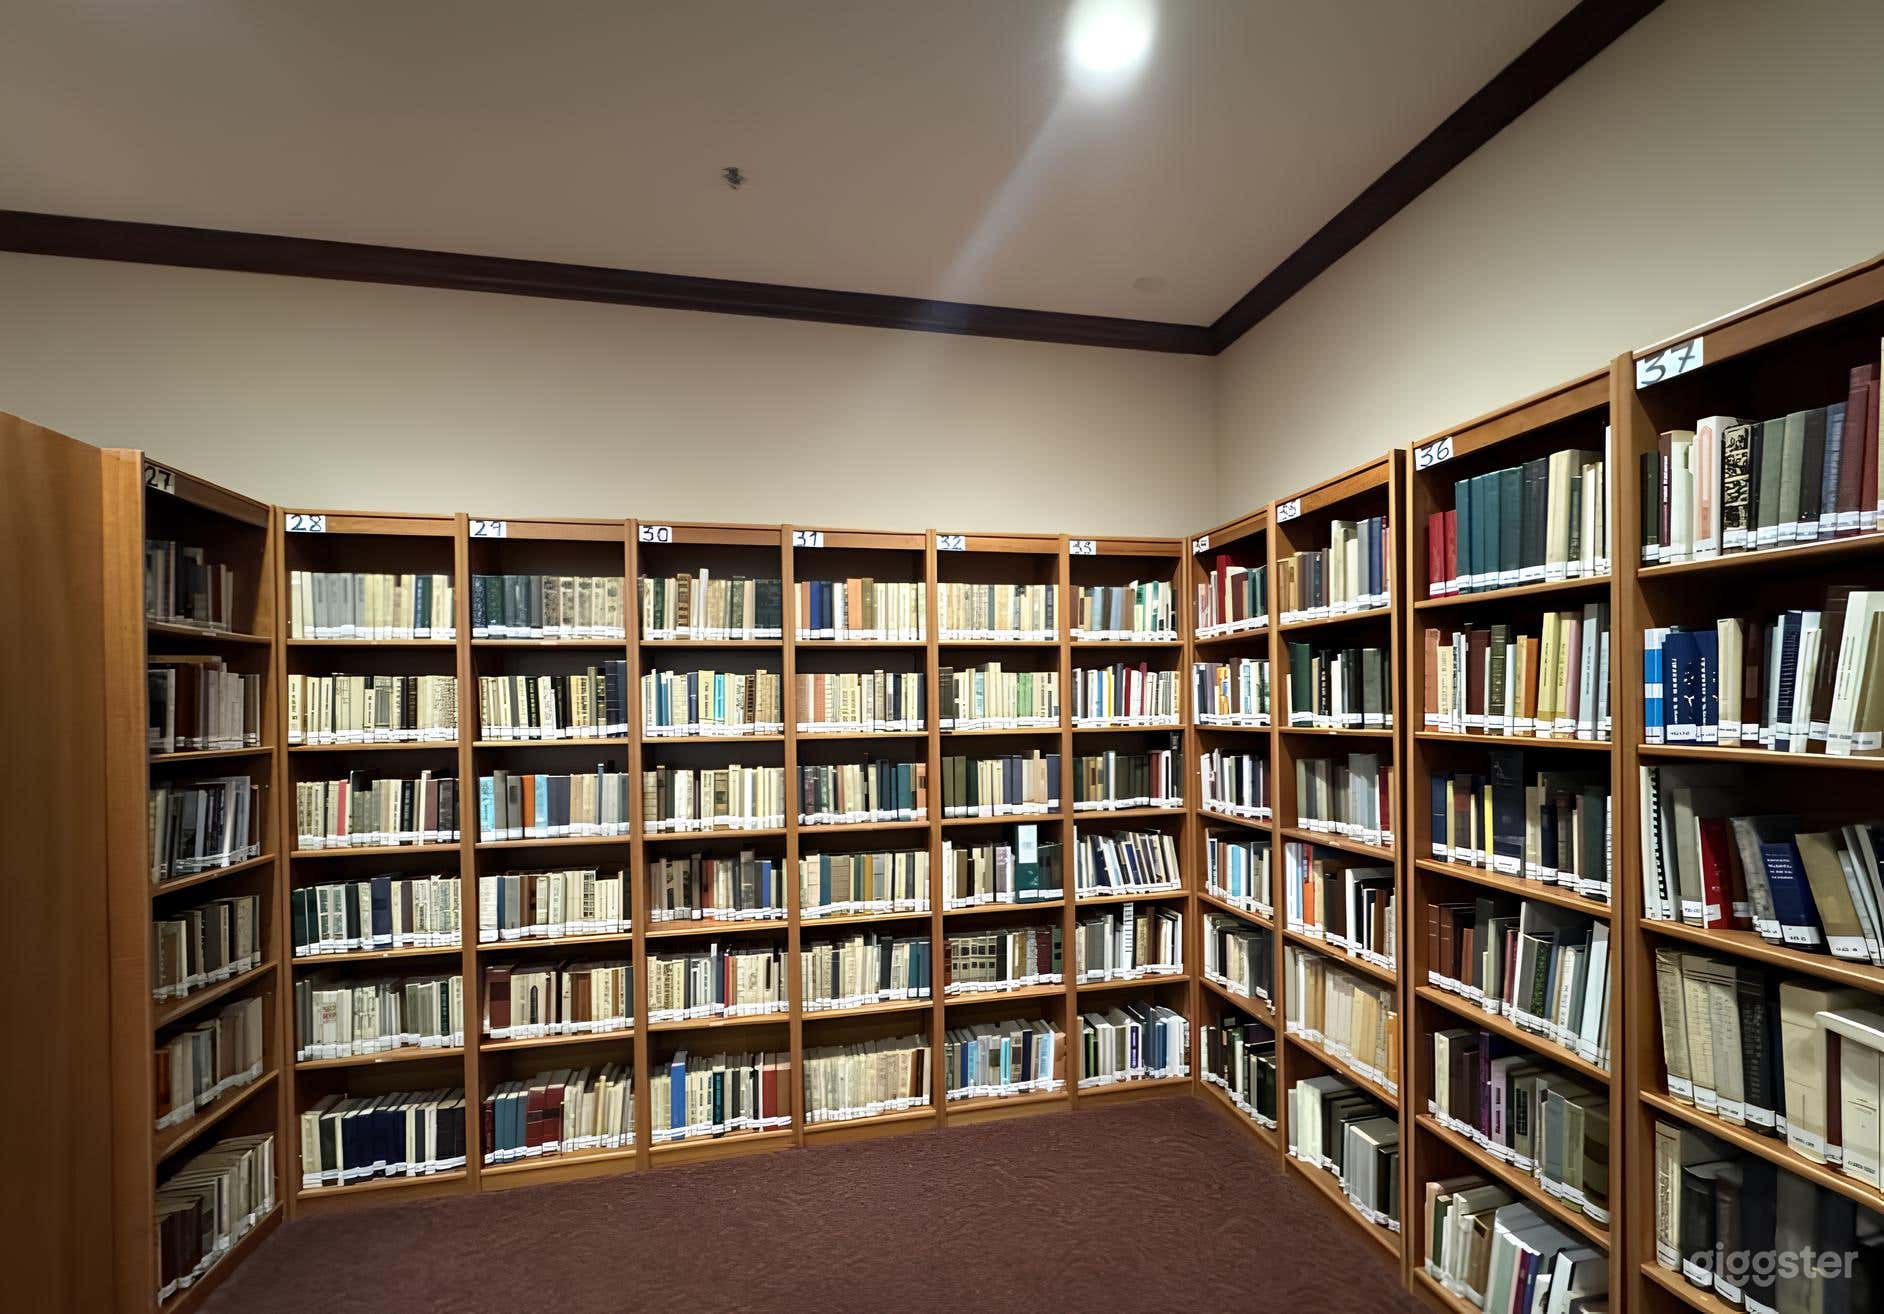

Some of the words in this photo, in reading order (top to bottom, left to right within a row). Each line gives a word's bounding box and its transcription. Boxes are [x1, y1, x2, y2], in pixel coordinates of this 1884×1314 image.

[1641, 341, 1695, 384] 37
[1420, 439, 1449, 467] 36
[145, 466, 170, 490] 27
[291, 515, 322, 531] 28
[643, 527, 669, 542] 30
[797, 531, 817, 547] 31
[940, 536, 963, 550] 32
